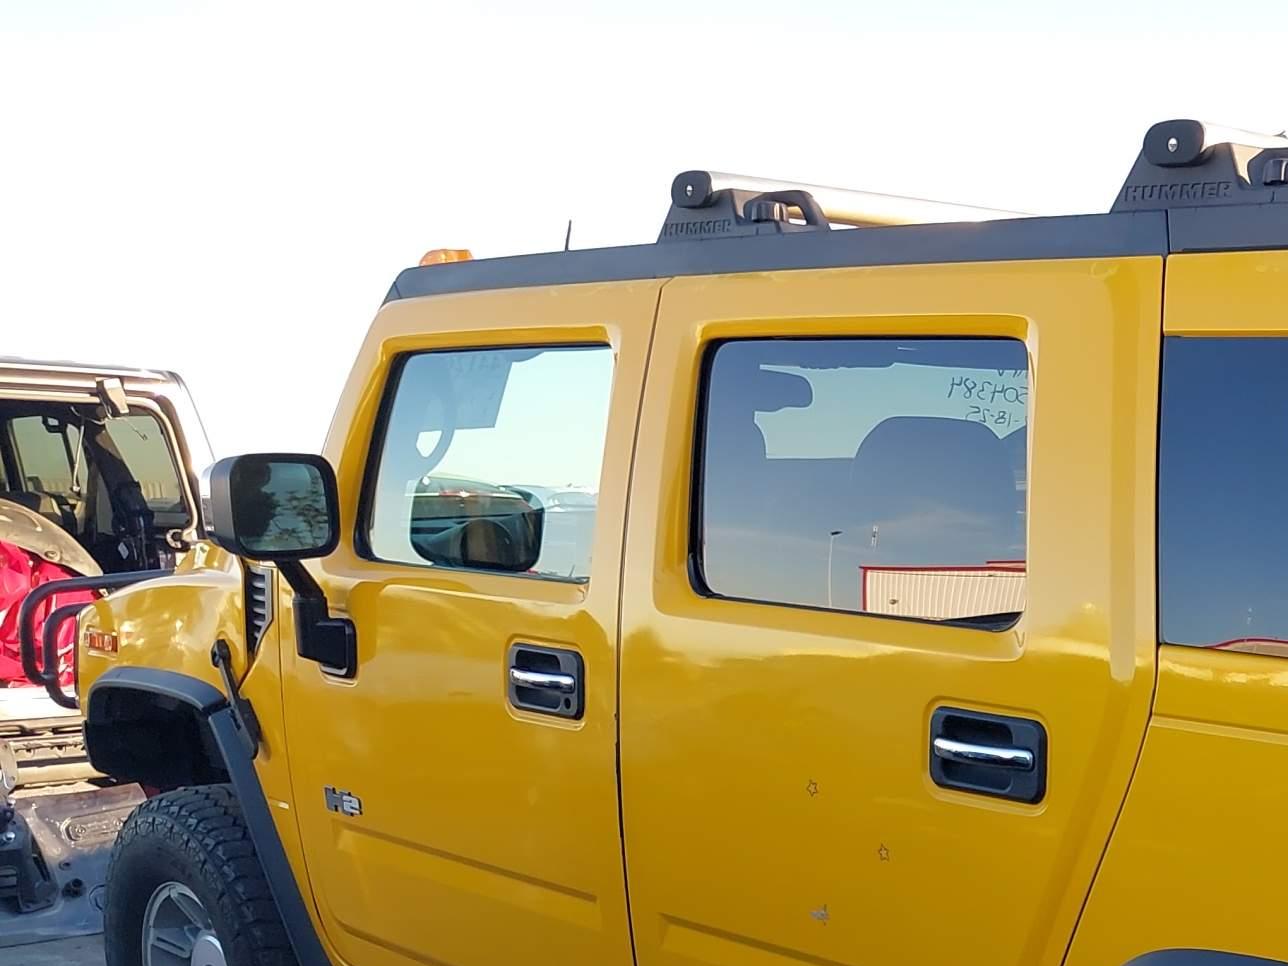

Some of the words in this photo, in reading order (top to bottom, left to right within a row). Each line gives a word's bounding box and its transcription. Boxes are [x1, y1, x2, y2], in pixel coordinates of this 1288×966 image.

[1124, 181, 1233, 202] HUMMER
[663, 219, 731, 237] HUMMER
[324, 786, 363, 817] H2
